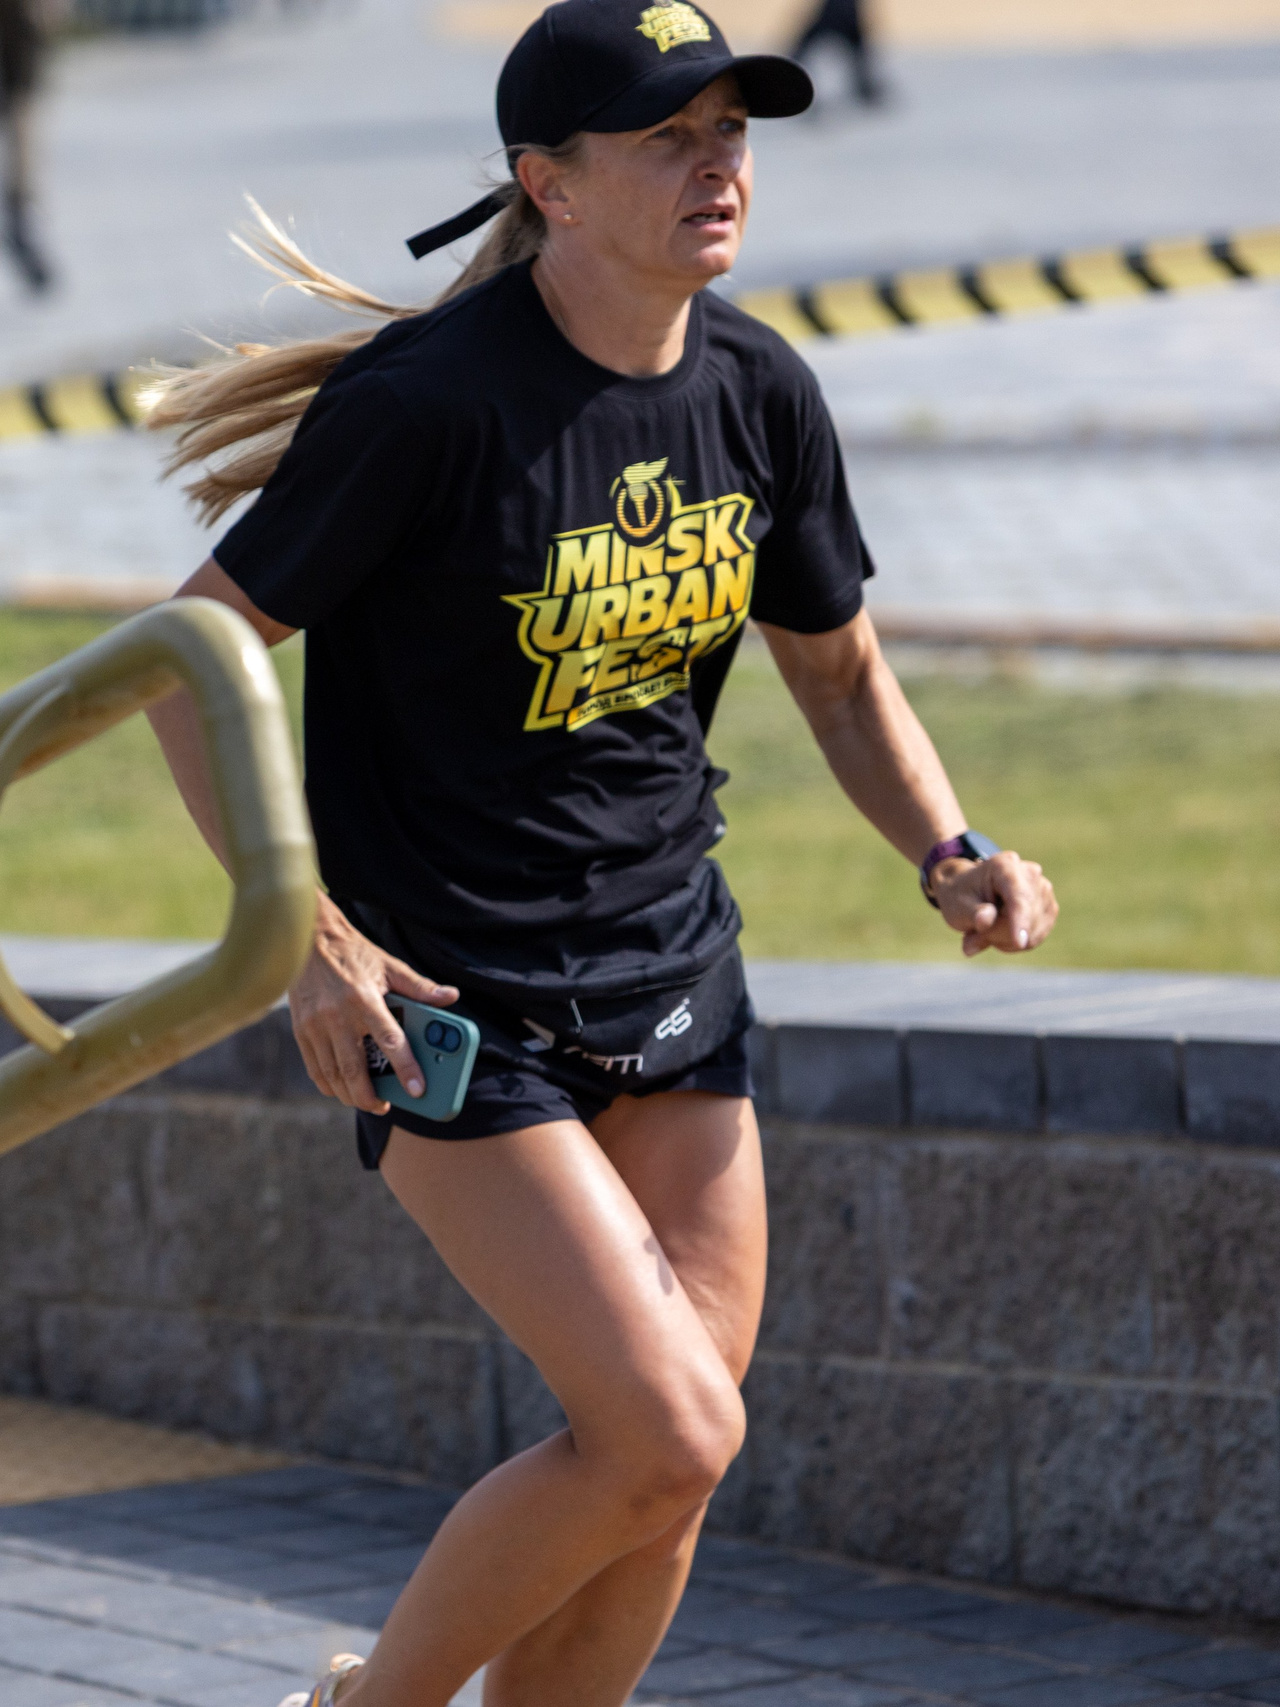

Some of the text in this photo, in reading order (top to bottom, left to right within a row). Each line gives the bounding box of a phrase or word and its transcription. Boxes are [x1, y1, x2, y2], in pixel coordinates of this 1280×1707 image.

[552, 501, 744, 598] MINSK
[529, 551, 752, 651] URBAN
[544, 613, 732, 715] FEST
